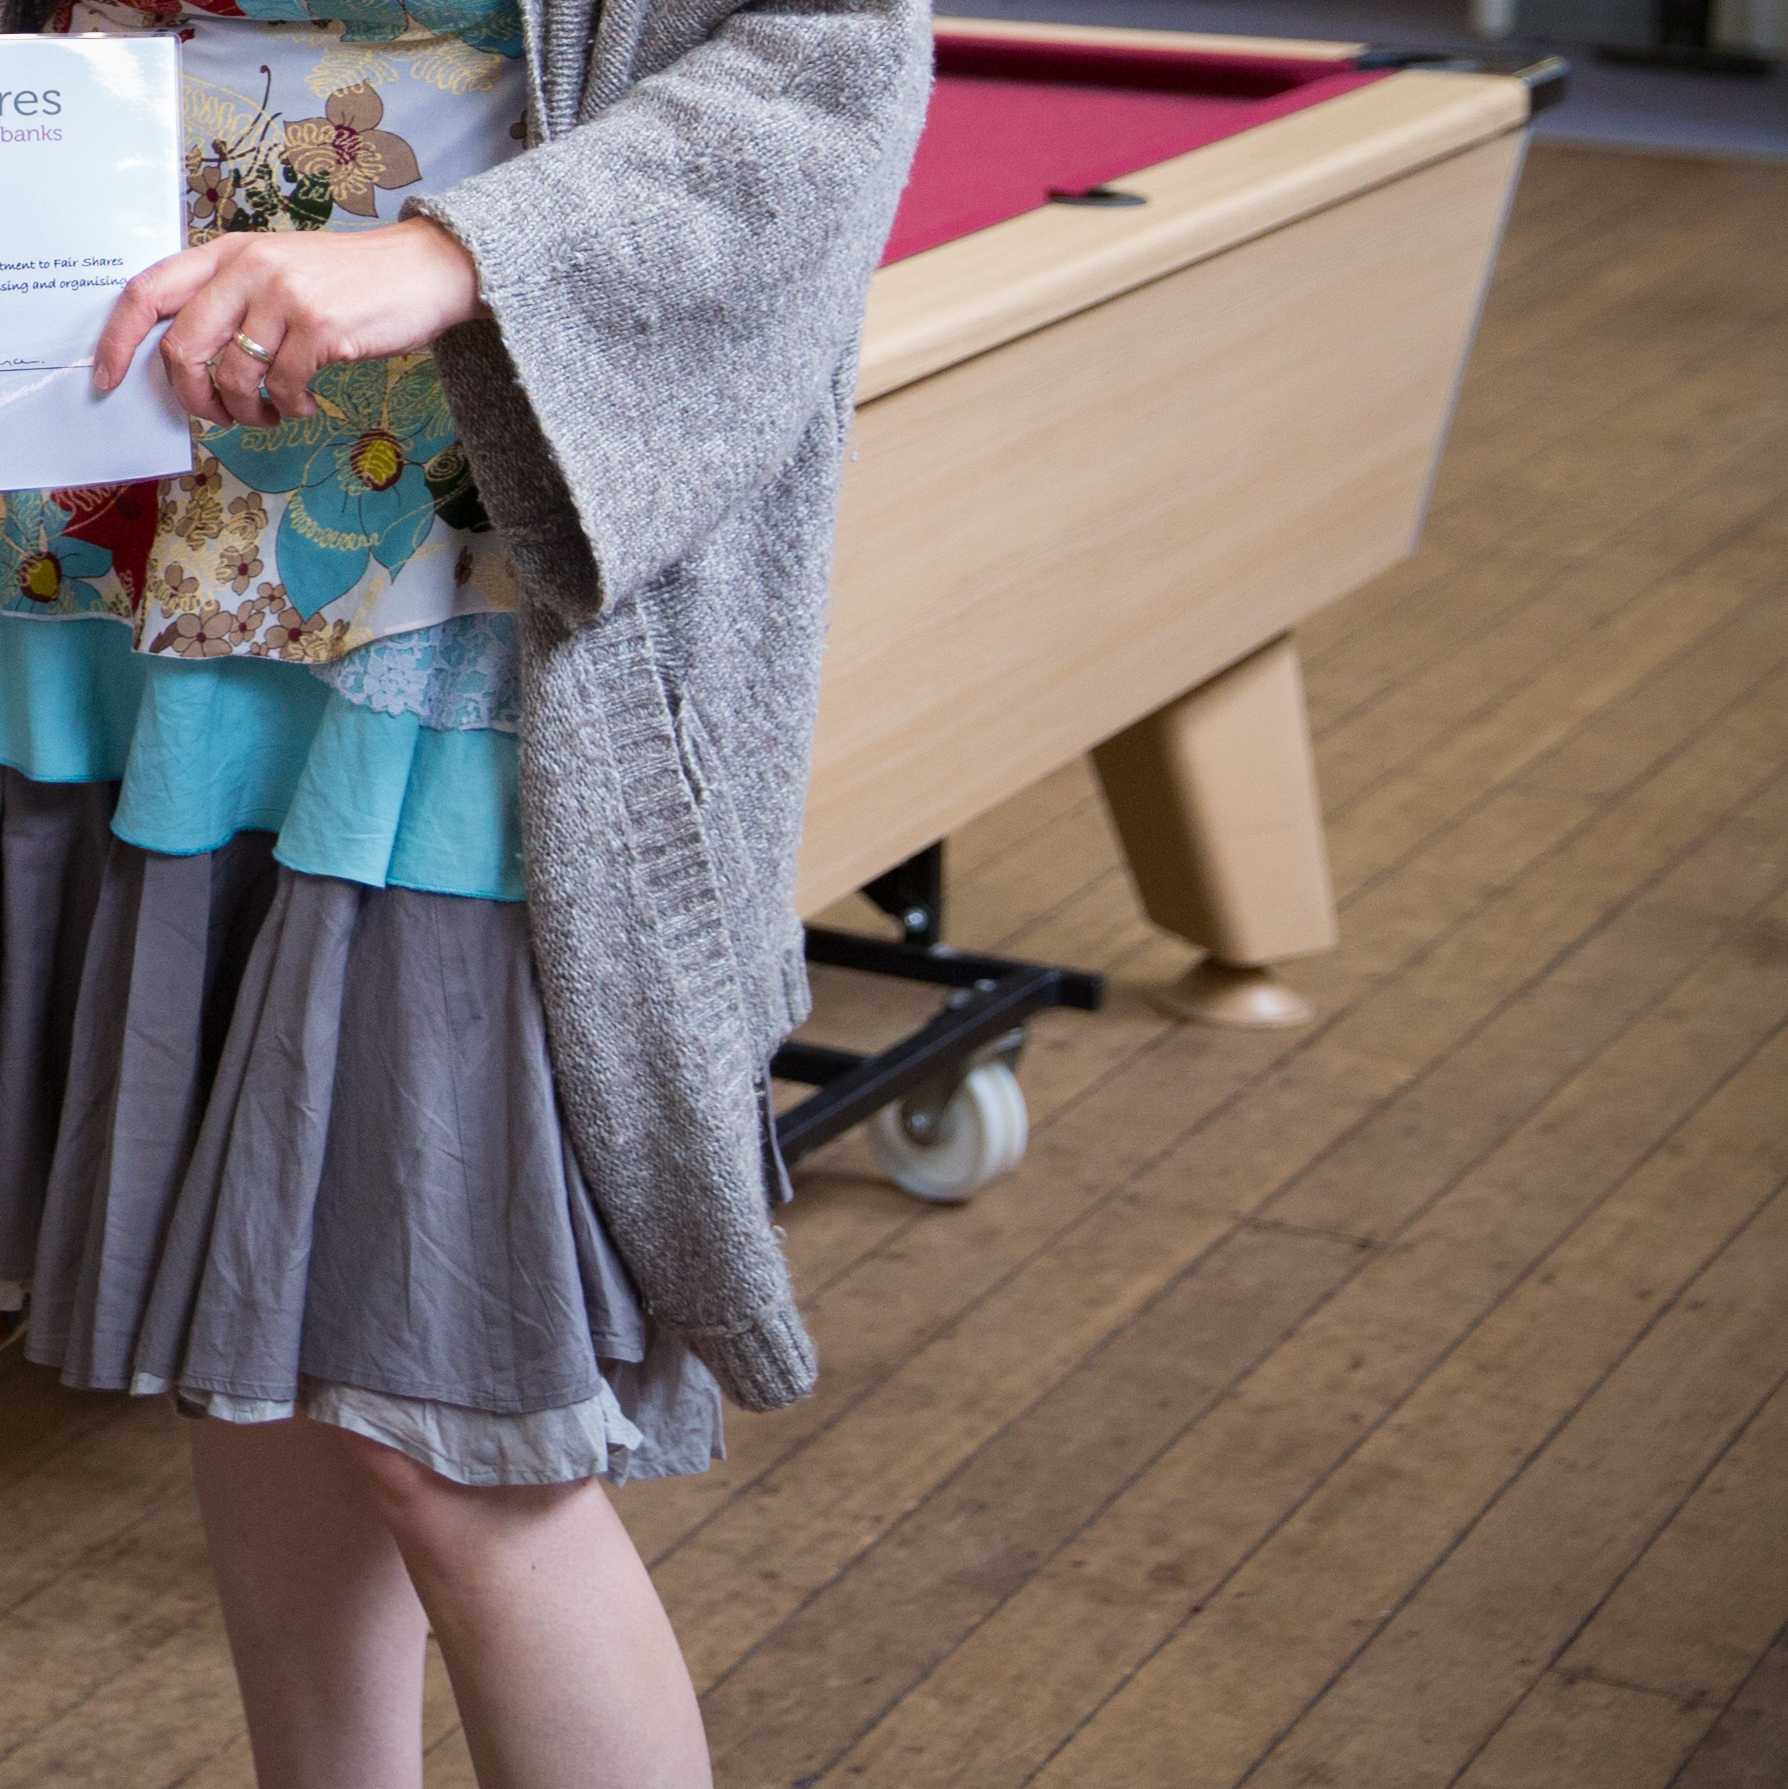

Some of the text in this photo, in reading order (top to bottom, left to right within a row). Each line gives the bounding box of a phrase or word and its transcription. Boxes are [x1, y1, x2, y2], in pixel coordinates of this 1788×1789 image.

[0, 125, 63, 143] banks
[39, 260, 50, 269] to
[53, 257, 79, 268] Fair
[81, 256, 124, 267] Shares
[32, 278, 56, 289] and
[59, 275, 128, 291] organising
